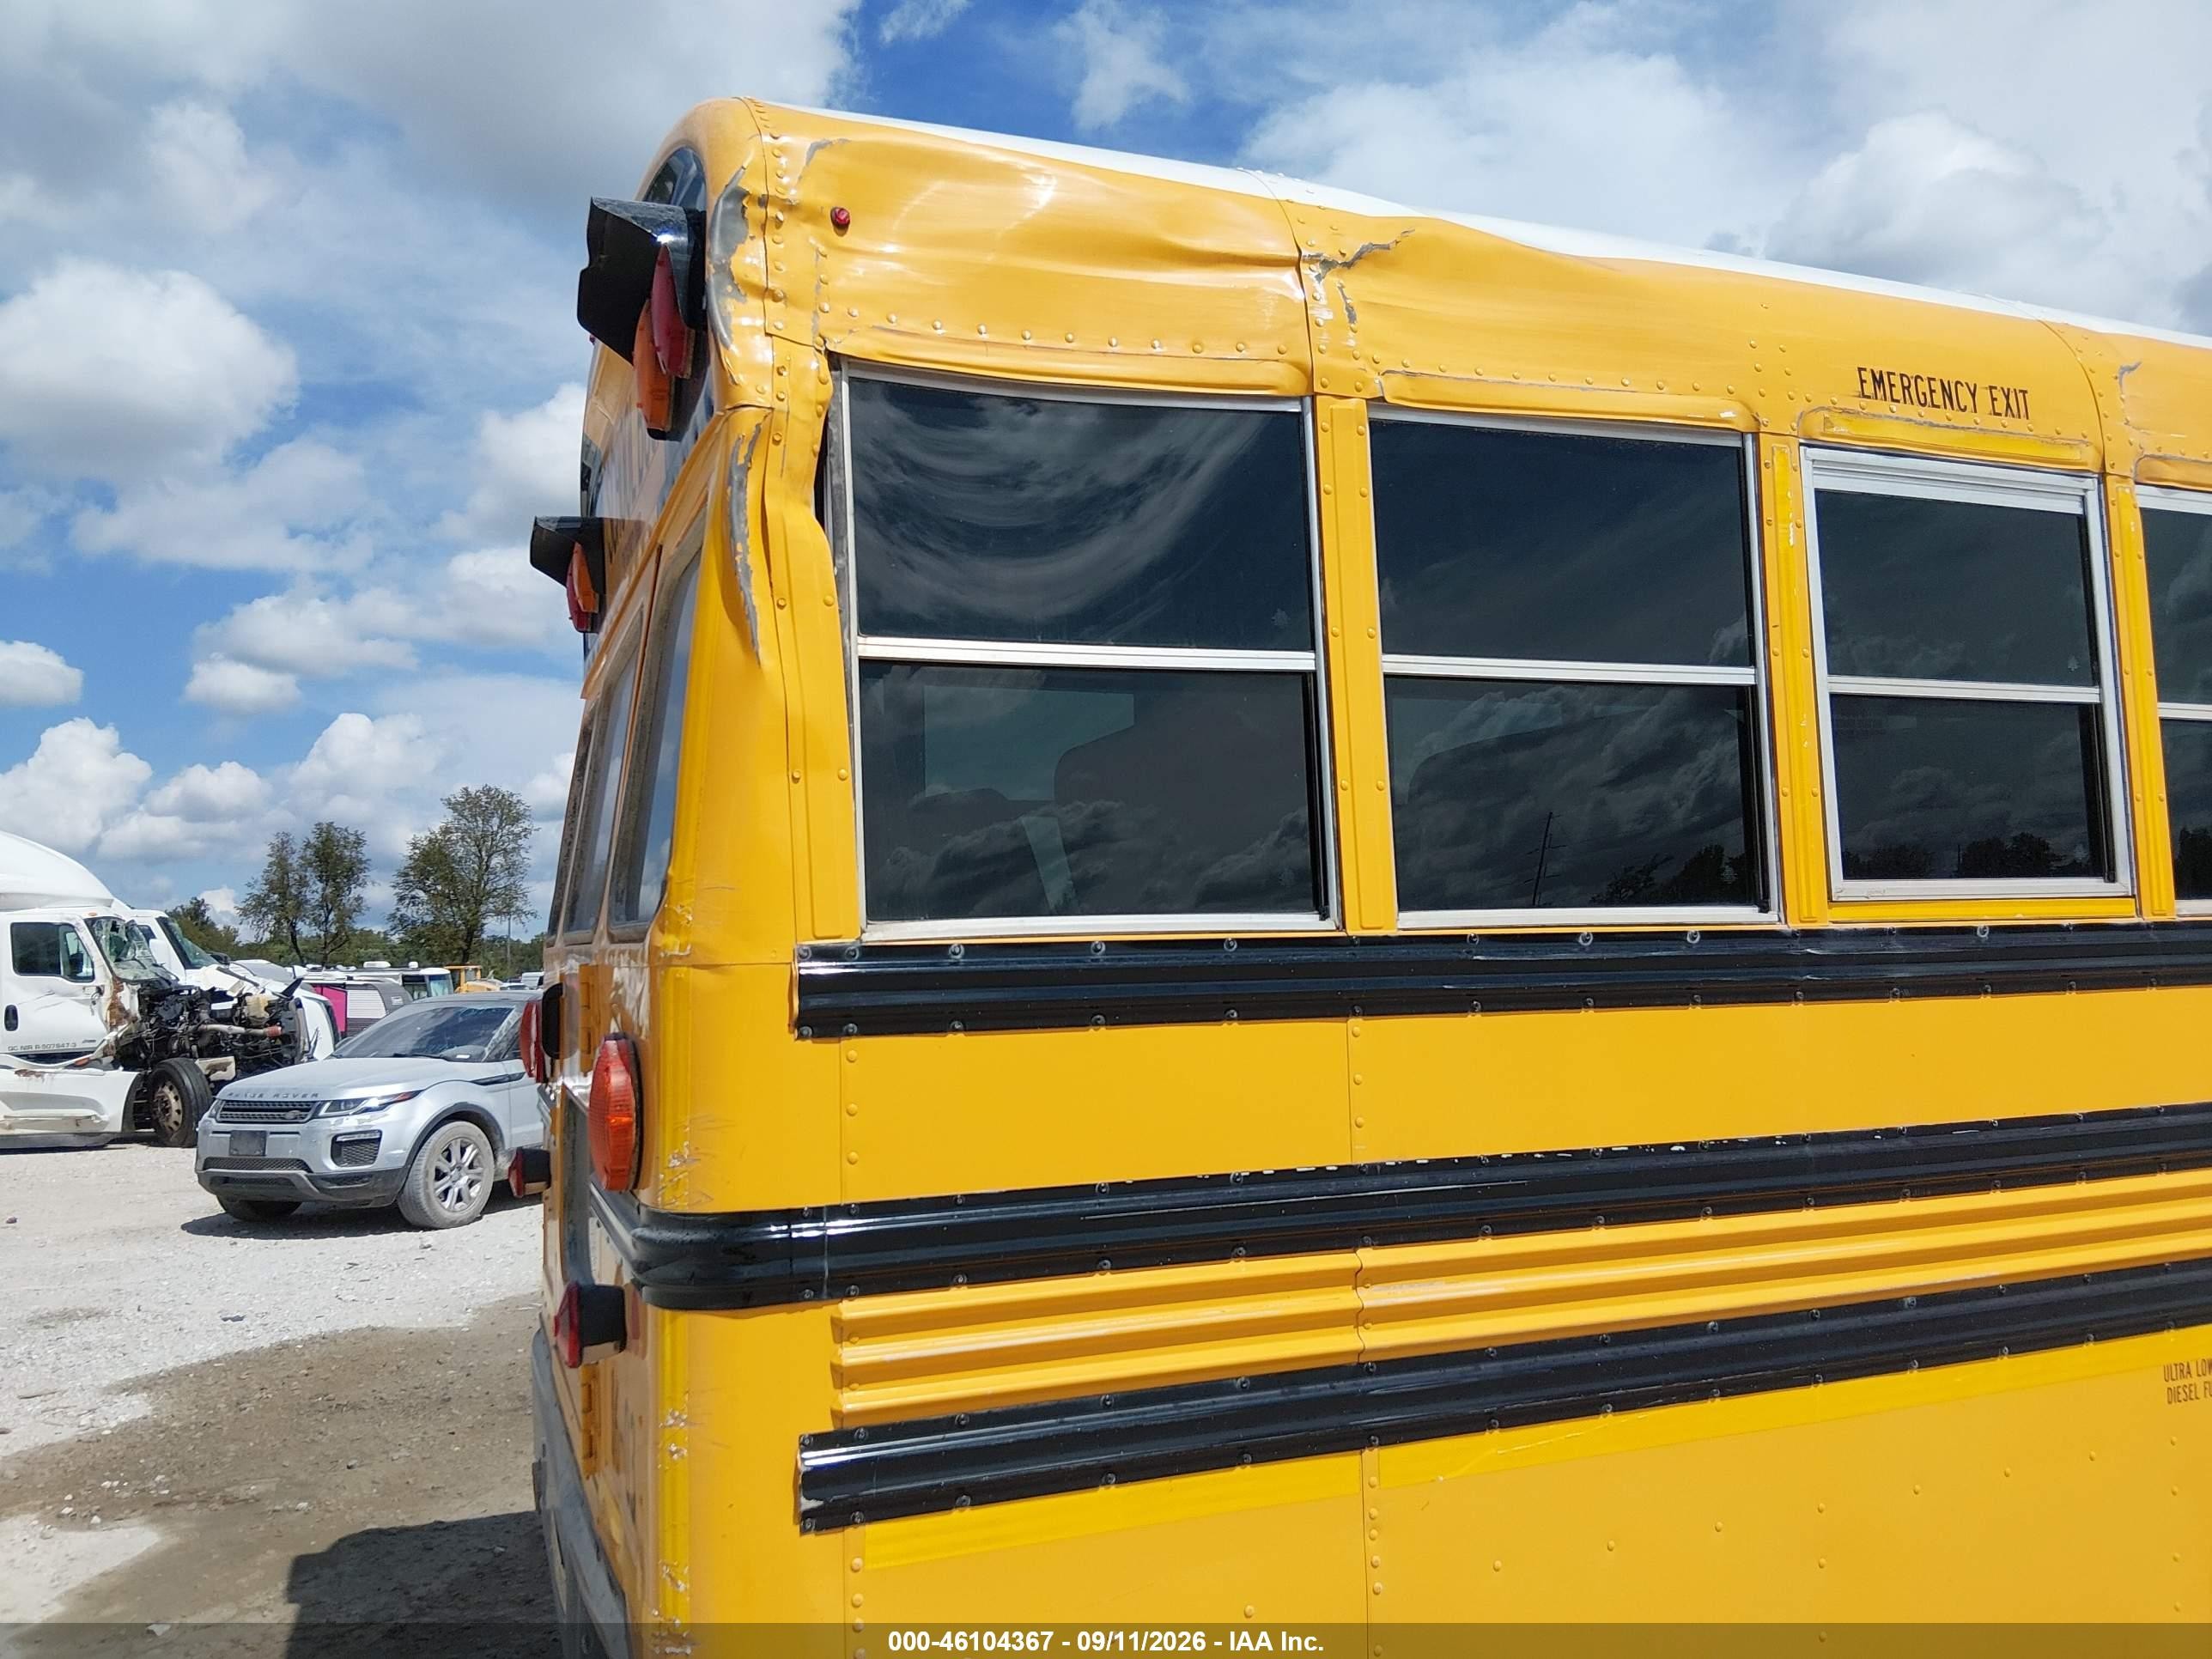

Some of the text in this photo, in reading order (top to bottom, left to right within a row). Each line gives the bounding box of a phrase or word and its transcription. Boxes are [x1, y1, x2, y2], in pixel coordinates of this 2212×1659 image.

[1856, 367, 2029, 420] EMERGENCY EXIT
[2163, 1361, 2192, 1382] ULTRA
[2166, 1382, 2200, 1405] DIESEL
